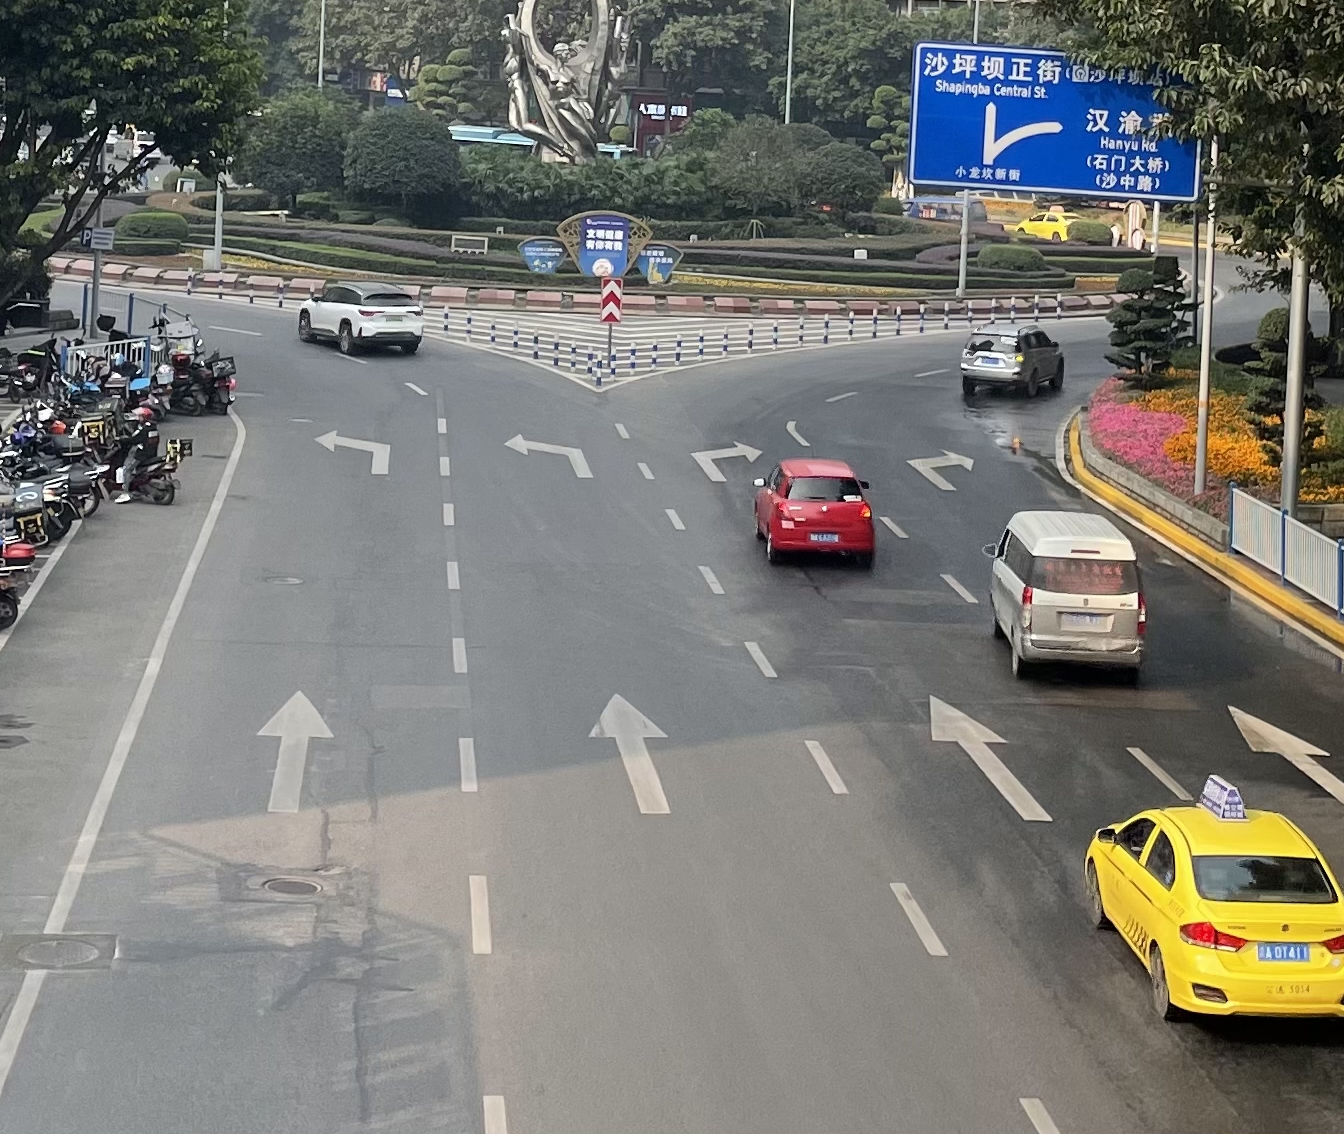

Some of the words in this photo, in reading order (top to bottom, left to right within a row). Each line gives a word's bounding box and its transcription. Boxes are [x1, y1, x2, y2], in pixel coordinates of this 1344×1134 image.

[923, 52, 1062, 84] 沙坪坝正街
[935, 79, 990, 98] Shapingba
[994, 83, 1031, 98] Central
[1034, 86, 1049, 99] St.
[1100, 135, 1138, 153] Hanyu
[955, 166, 1020, 182] 小龙坎新街
[1086, 154, 1170, 174] (石门大桥)
[1096, 172, 1160, 192] (沙中路)
